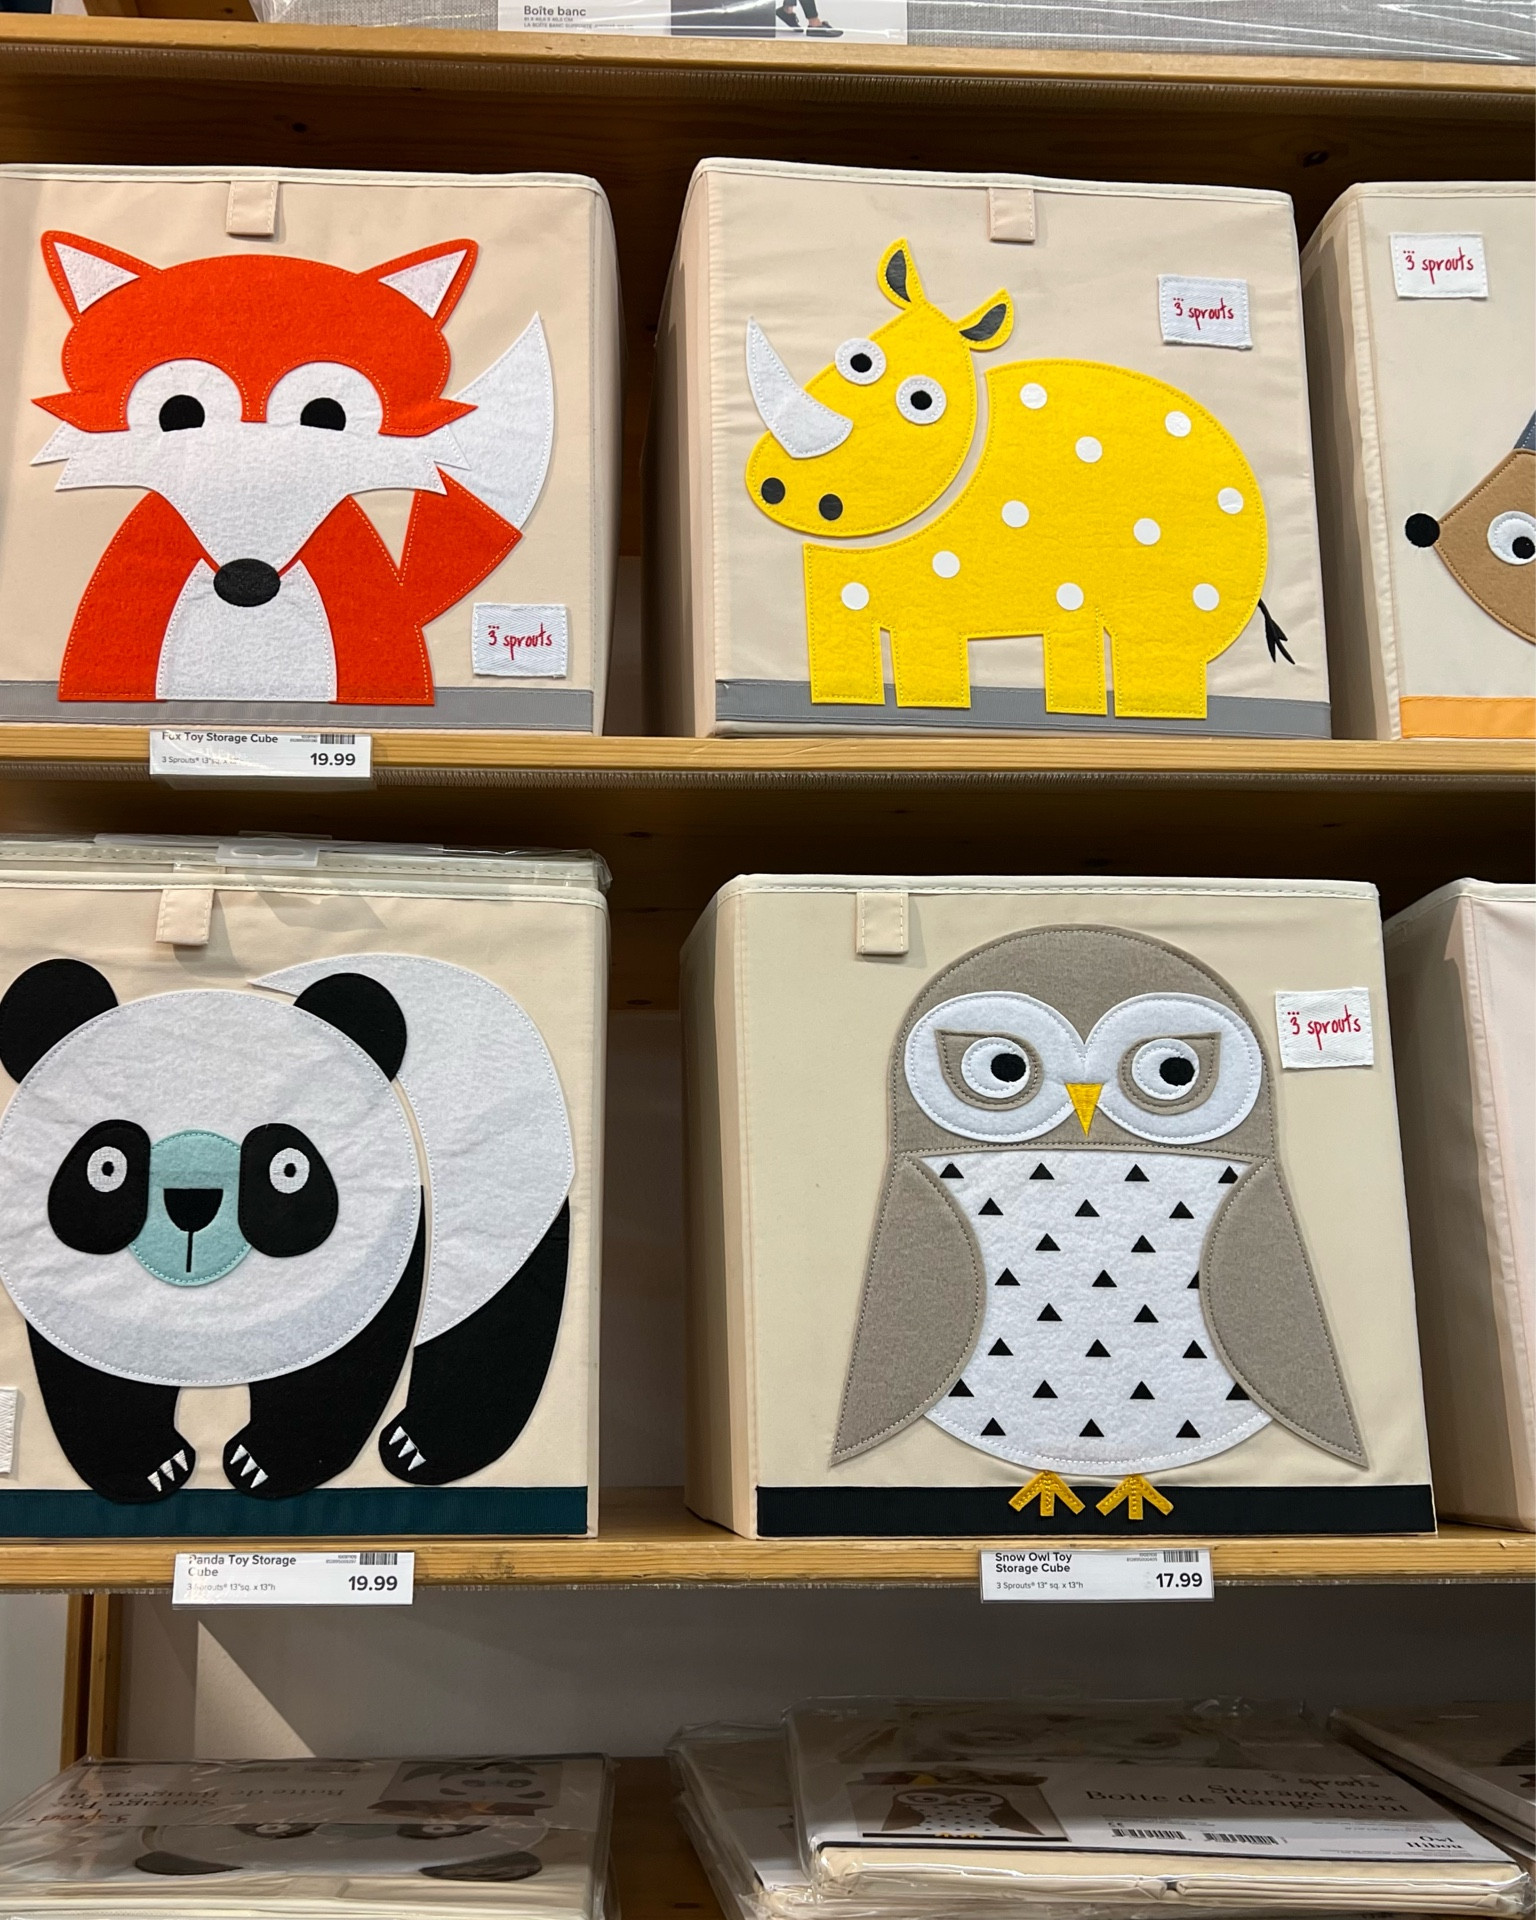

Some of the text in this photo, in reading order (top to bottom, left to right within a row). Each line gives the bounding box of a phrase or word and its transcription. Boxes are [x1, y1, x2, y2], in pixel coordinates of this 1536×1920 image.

[523, 5, 587, 17] Boîte banc
[1403, 246, 1474, 285] 3 sprouts
[1173, 297, 1235, 331] 3 sprouts
[488, 622, 553, 661] 3 sprouts
[184, 731, 204, 744] Toy
[206, 732, 247, 744] Storage
[250, 733, 279, 744] Cube
[310, 752, 356, 766] 19.99
[1287, 1004, 1361, 1051] 3 sprouts
[228, 1554, 249, 1567] Toy
[252, 1554, 297, 1568] Storage
[995, 1552, 1072, 1563] Snow Owl Toy
[995, 1563, 1071, 1575] Storage Cube
[348, 1575, 398, 1591] 19.99
[996, 1581, 1002, 1589] 3
[1156, 1572, 1203, 1588] 17.99
[1298, 1776, 1380, 1790] sprouts
[1207, 1785, 1397, 1801] Storage Box
[108, 1798, 215, 1807] Storage
[1178, 1794, 1216, 1804] de
[1225, 1795, 1410, 1812] Rangement
[1419, 1835, 1454, 1843] Owl
